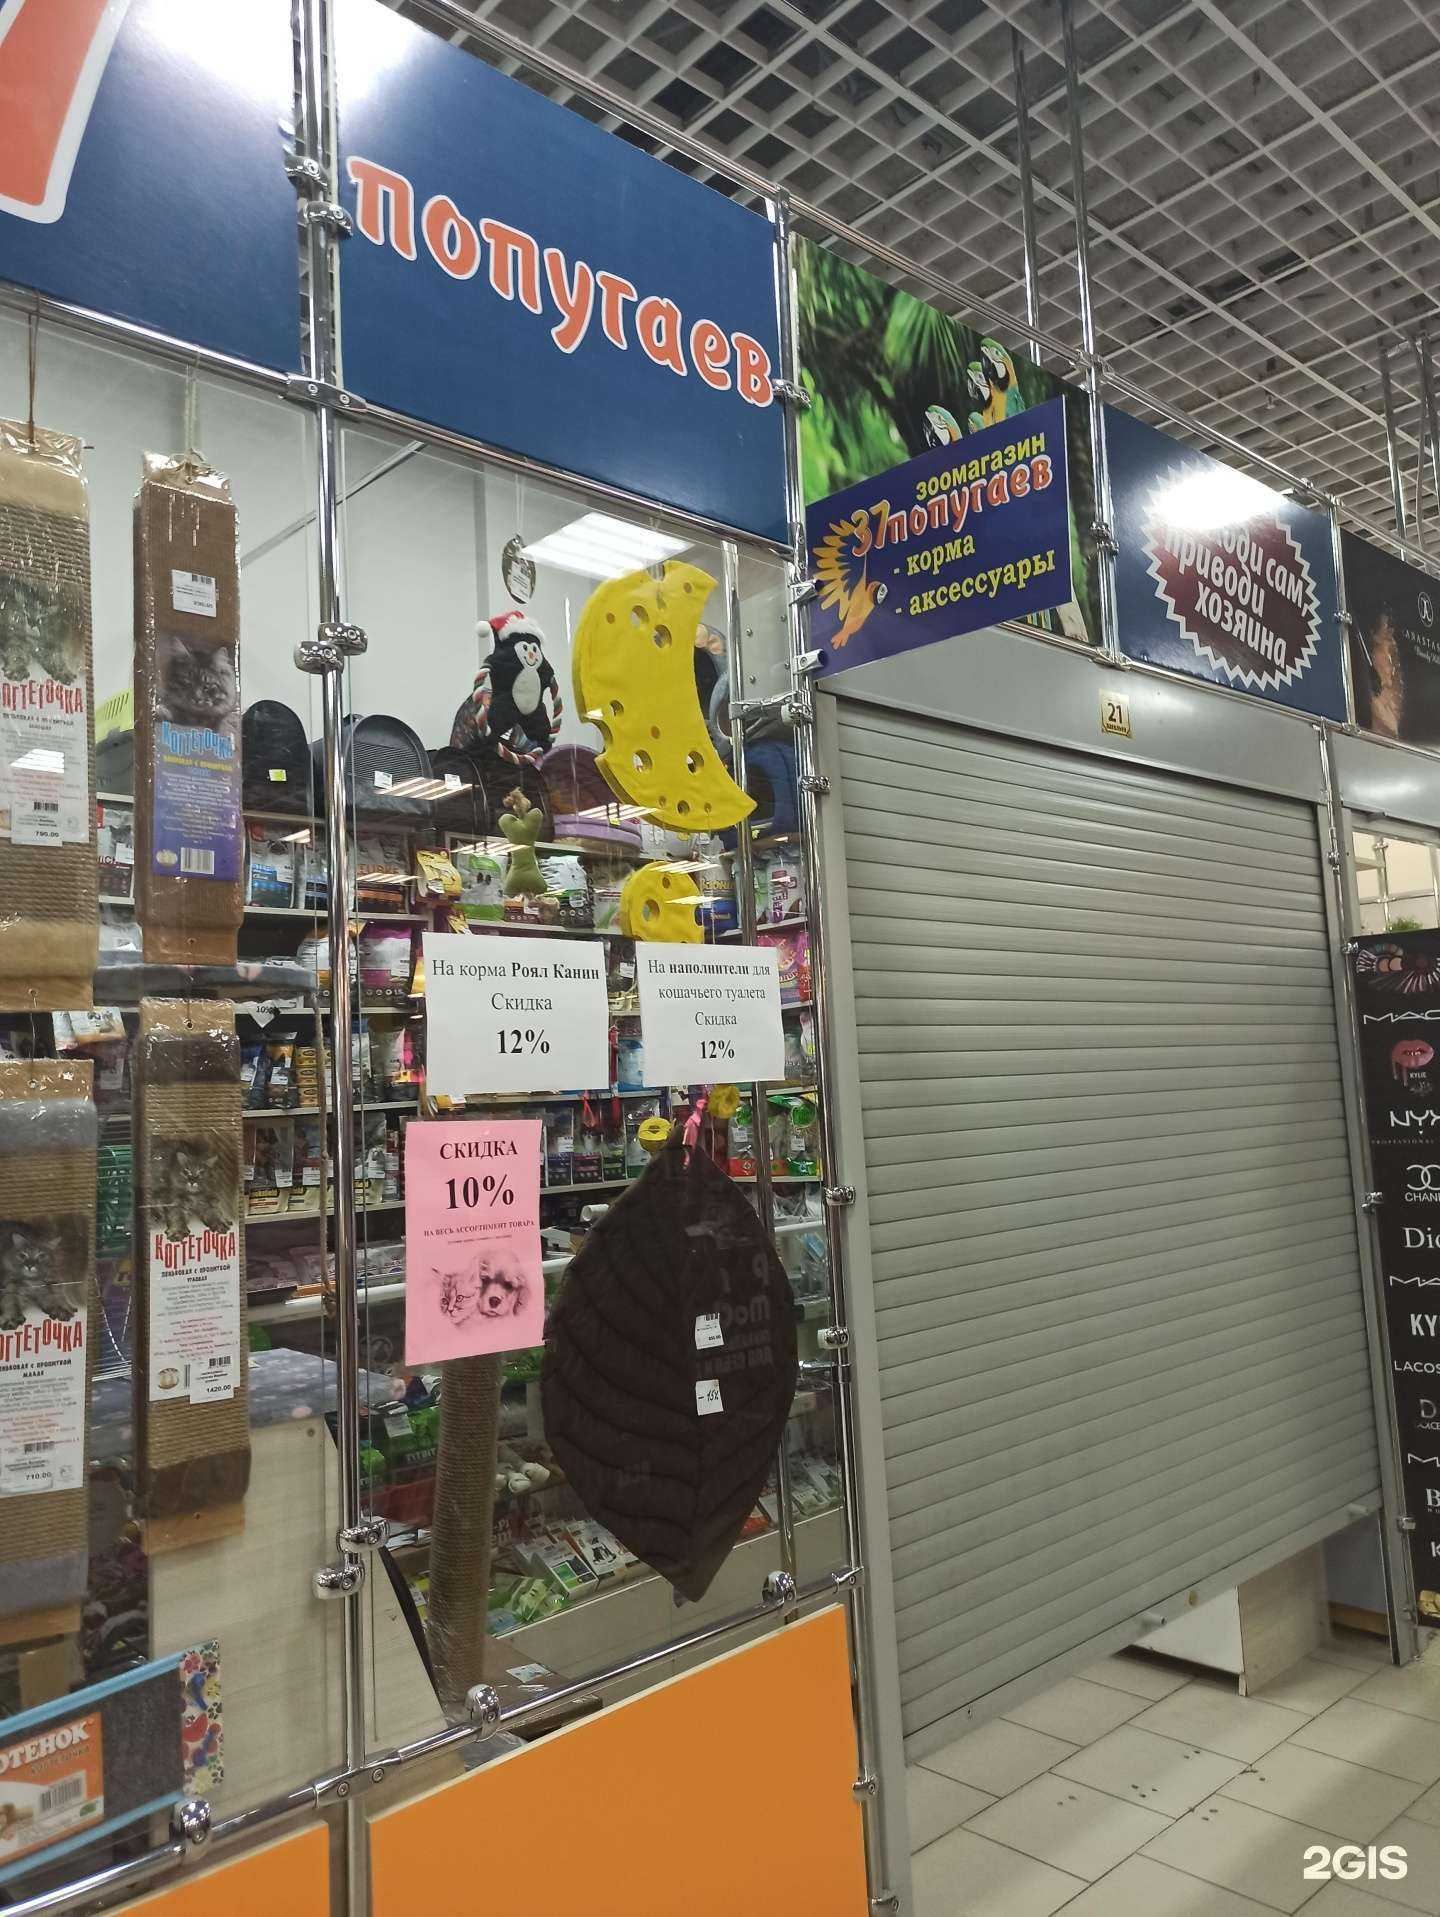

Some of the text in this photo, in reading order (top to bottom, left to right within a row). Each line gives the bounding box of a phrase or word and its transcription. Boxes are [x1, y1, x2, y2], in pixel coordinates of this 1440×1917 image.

[347, 156, 775, 407] попугаев
[916, 432, 1046, 501] зоомагазин
[851, 454, 1053, 557] 37 попугаев
[906, 534, 976, 578] корма
[909, 548, 1056, 616] аксессуары
[1195, 581, 1287, 669] хозяина
[1107, 702, 1123, 724] 21
[432, 960, 600, 981] На корма Роял Канин
[648, 959, 666, 974] На
[669, 961, 749, 976] наполнители
[752, 965, 771, 977] для
[491, 992, 553, 1011] Скидка
[658, 986, 766, 1002] кошачьего туалета
[694, 1011, 738, 1027] Скидка
[497, 1028, 551, 1054] 12%
[699, 1039, 735, 1060] 12%
[439, 1140, 518, 1160] СКИДКА
[445, 1173, 515, 1210] 10%
[1405, 1192, 1440, 1203] CHAN
